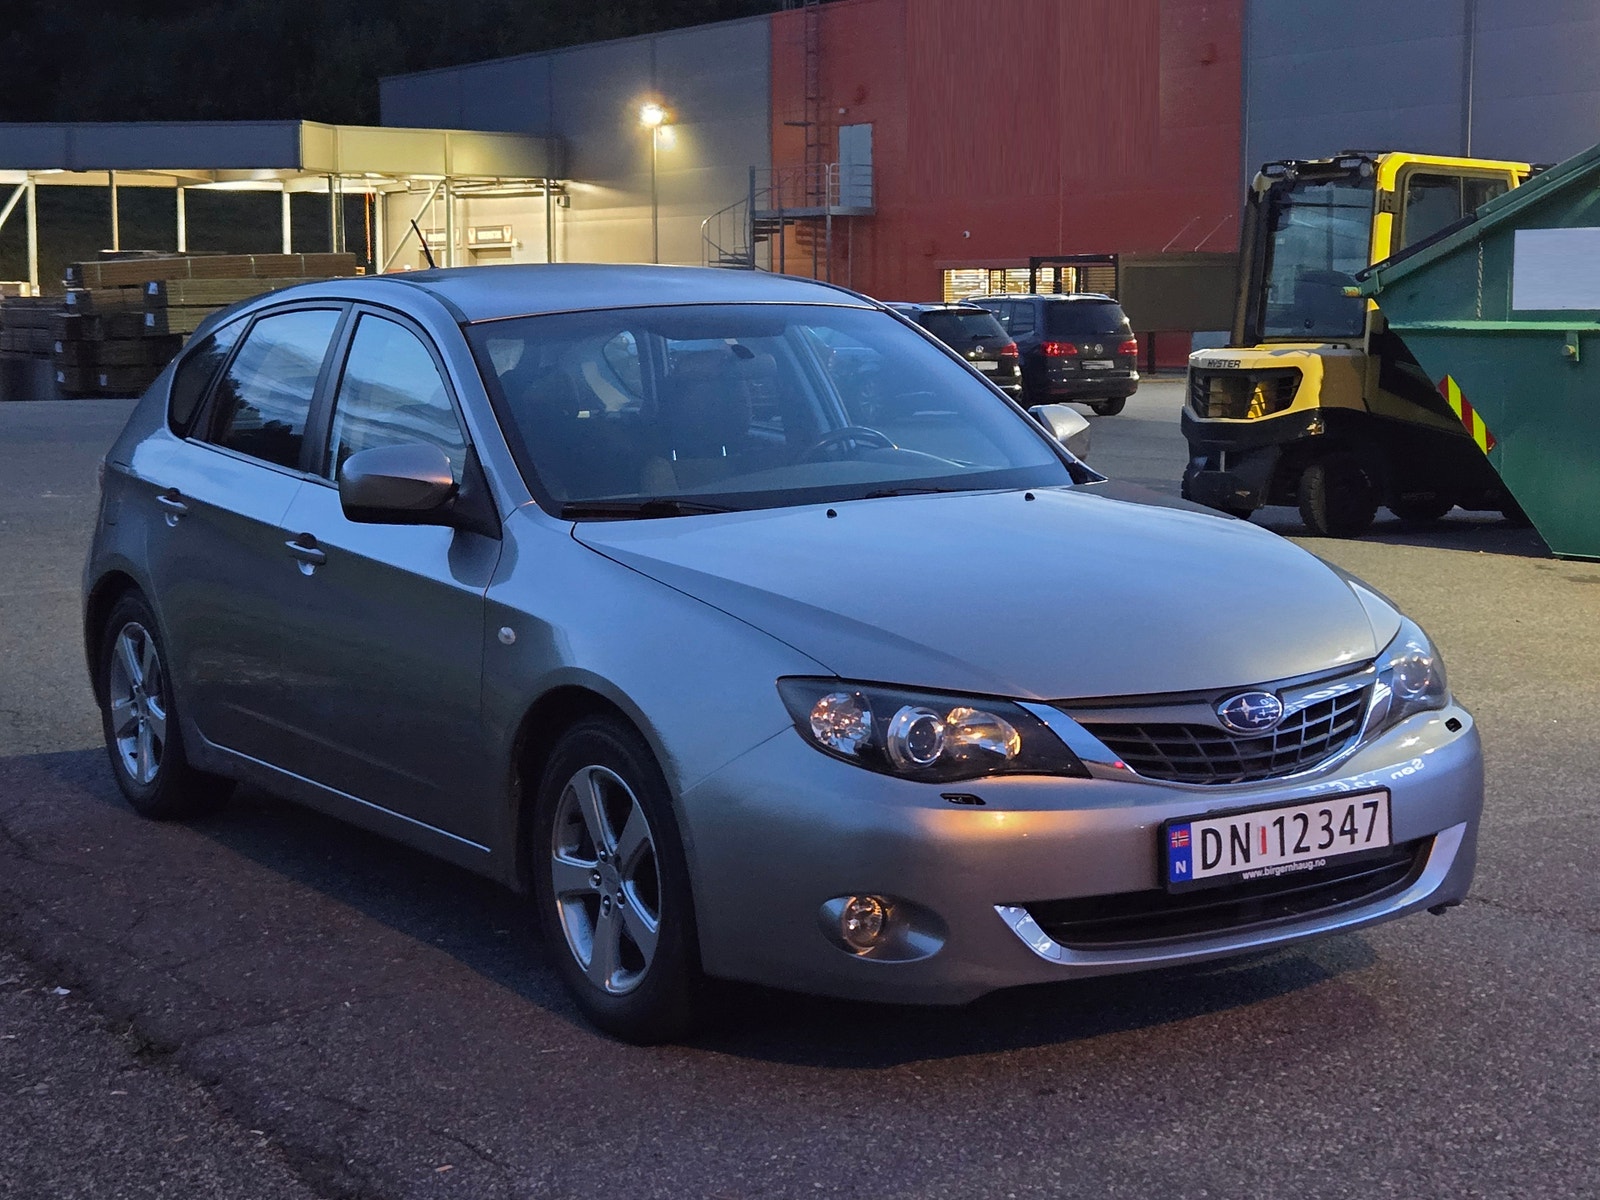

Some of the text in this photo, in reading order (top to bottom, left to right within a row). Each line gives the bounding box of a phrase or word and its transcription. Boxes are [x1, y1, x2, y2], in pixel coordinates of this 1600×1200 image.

[1207, 359, 1241, 368] HYSTER
[1175, 860, 1187, 874] N
[1242, 859, 1326, 880] www.birgernhaug.no
